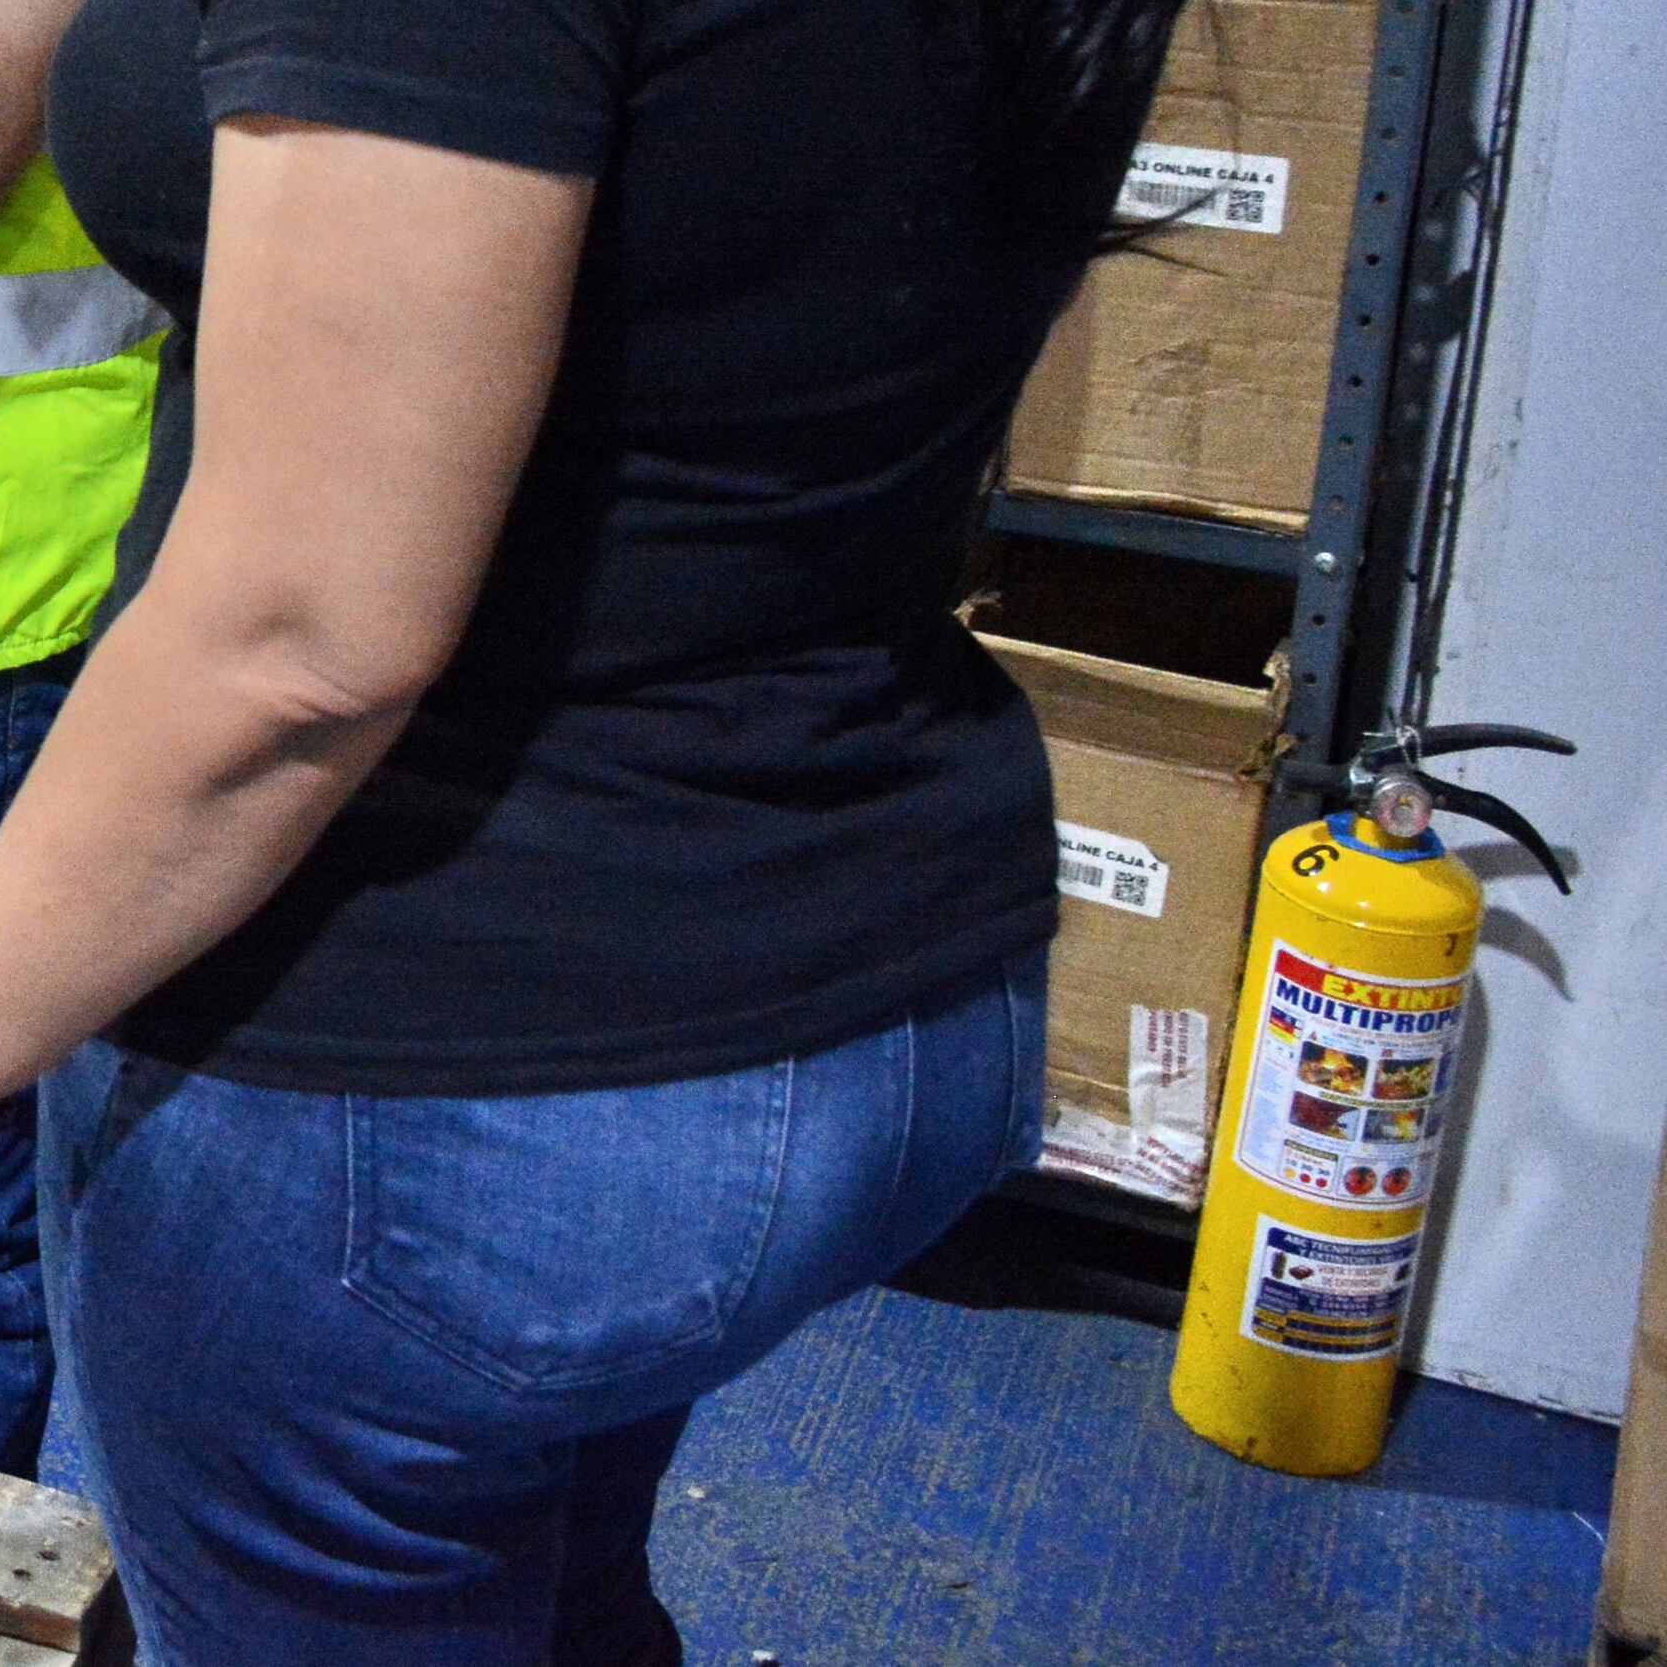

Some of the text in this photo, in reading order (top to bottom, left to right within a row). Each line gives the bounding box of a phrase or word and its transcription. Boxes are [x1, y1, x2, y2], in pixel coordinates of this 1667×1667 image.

[1153, 162, 1212, 178] ONLINE
[1216, 167, 1260, 183] CAJA
[1263, 172, 1275, 184] 4
[1058, 838, 1158, 872] NLINE CAJA 4
